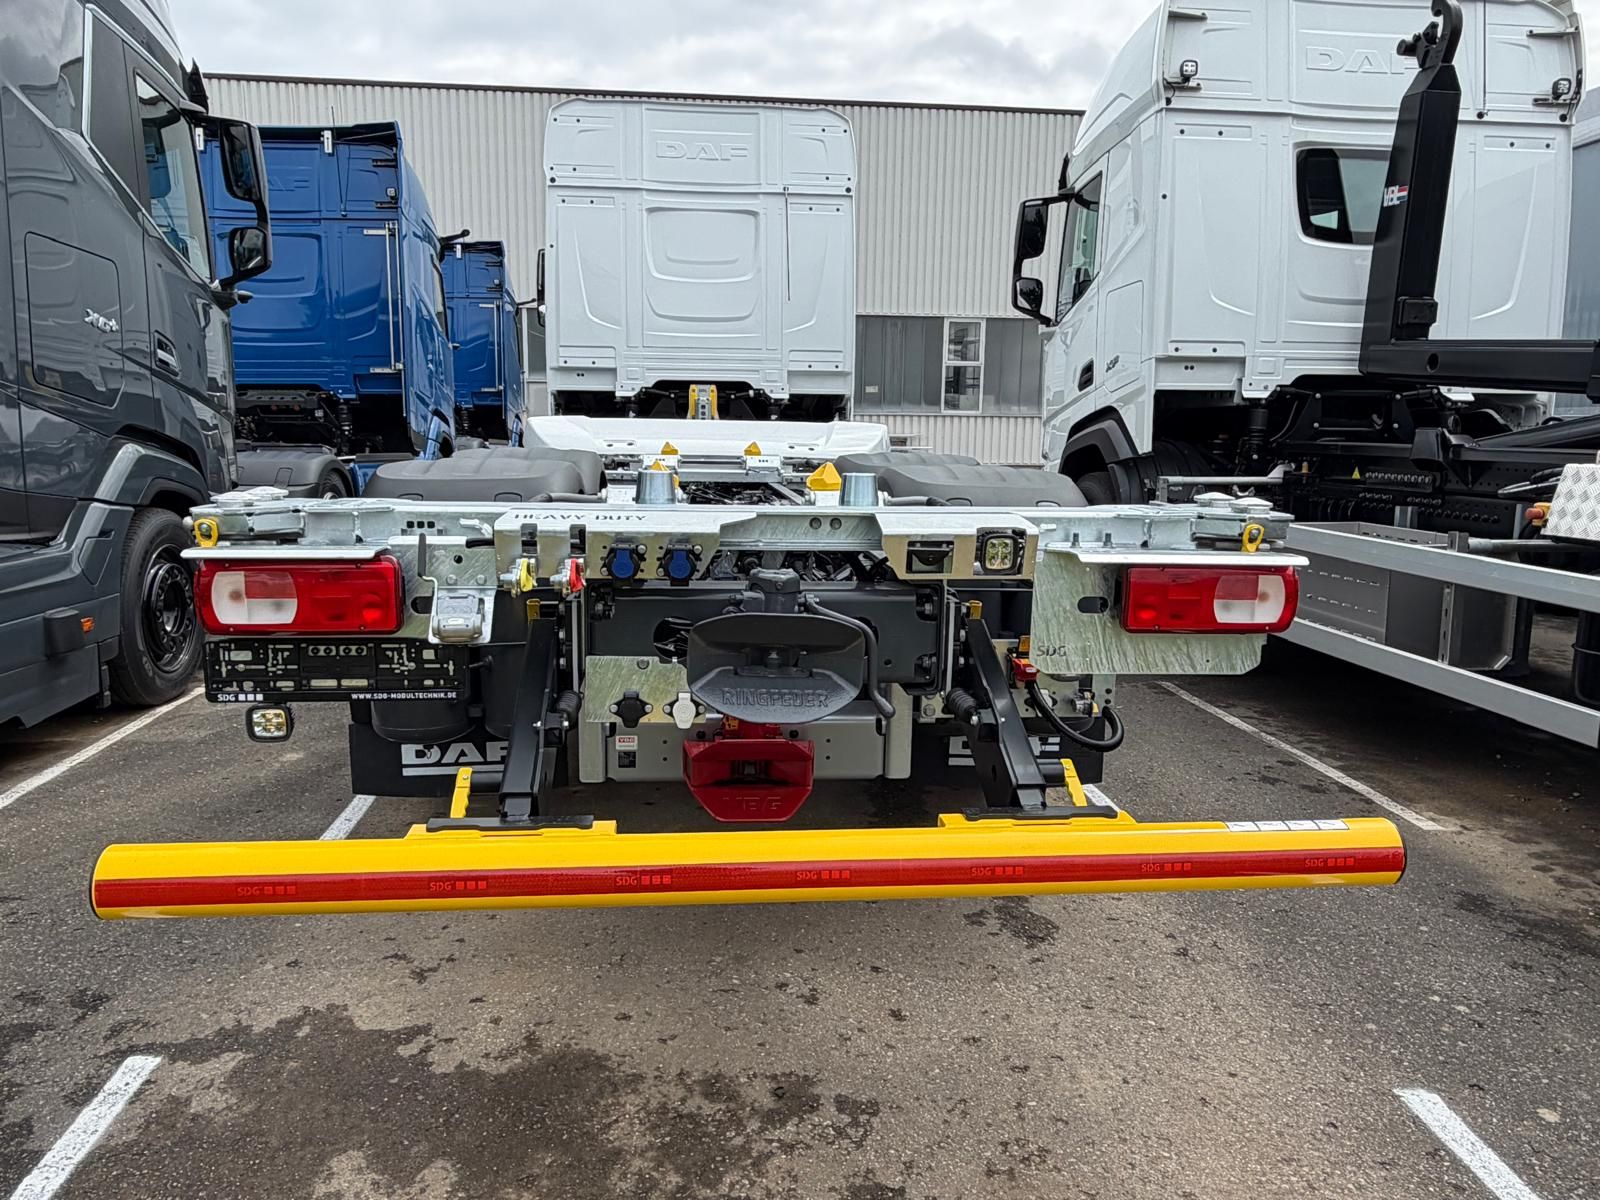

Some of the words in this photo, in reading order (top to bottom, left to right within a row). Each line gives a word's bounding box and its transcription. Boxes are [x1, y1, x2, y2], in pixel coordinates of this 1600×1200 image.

[655, 140, 748, 161] DAF
[1036, 645, 1067, 657] SDG
[721, 688, 829, 707] RINGFEDER
[401, 741, 509, 765] DAF
[1141, 863, 1161, 872] SDG
[1304, 859, 1324, 867] SDG
[796, 871, 817, 880] SDG
[971, 867, 992, 876] SDG
[430, 881, 452, 891] SDG
[615, 876, 637, 886] SDG
[237, 887, 260, 897] SDG
